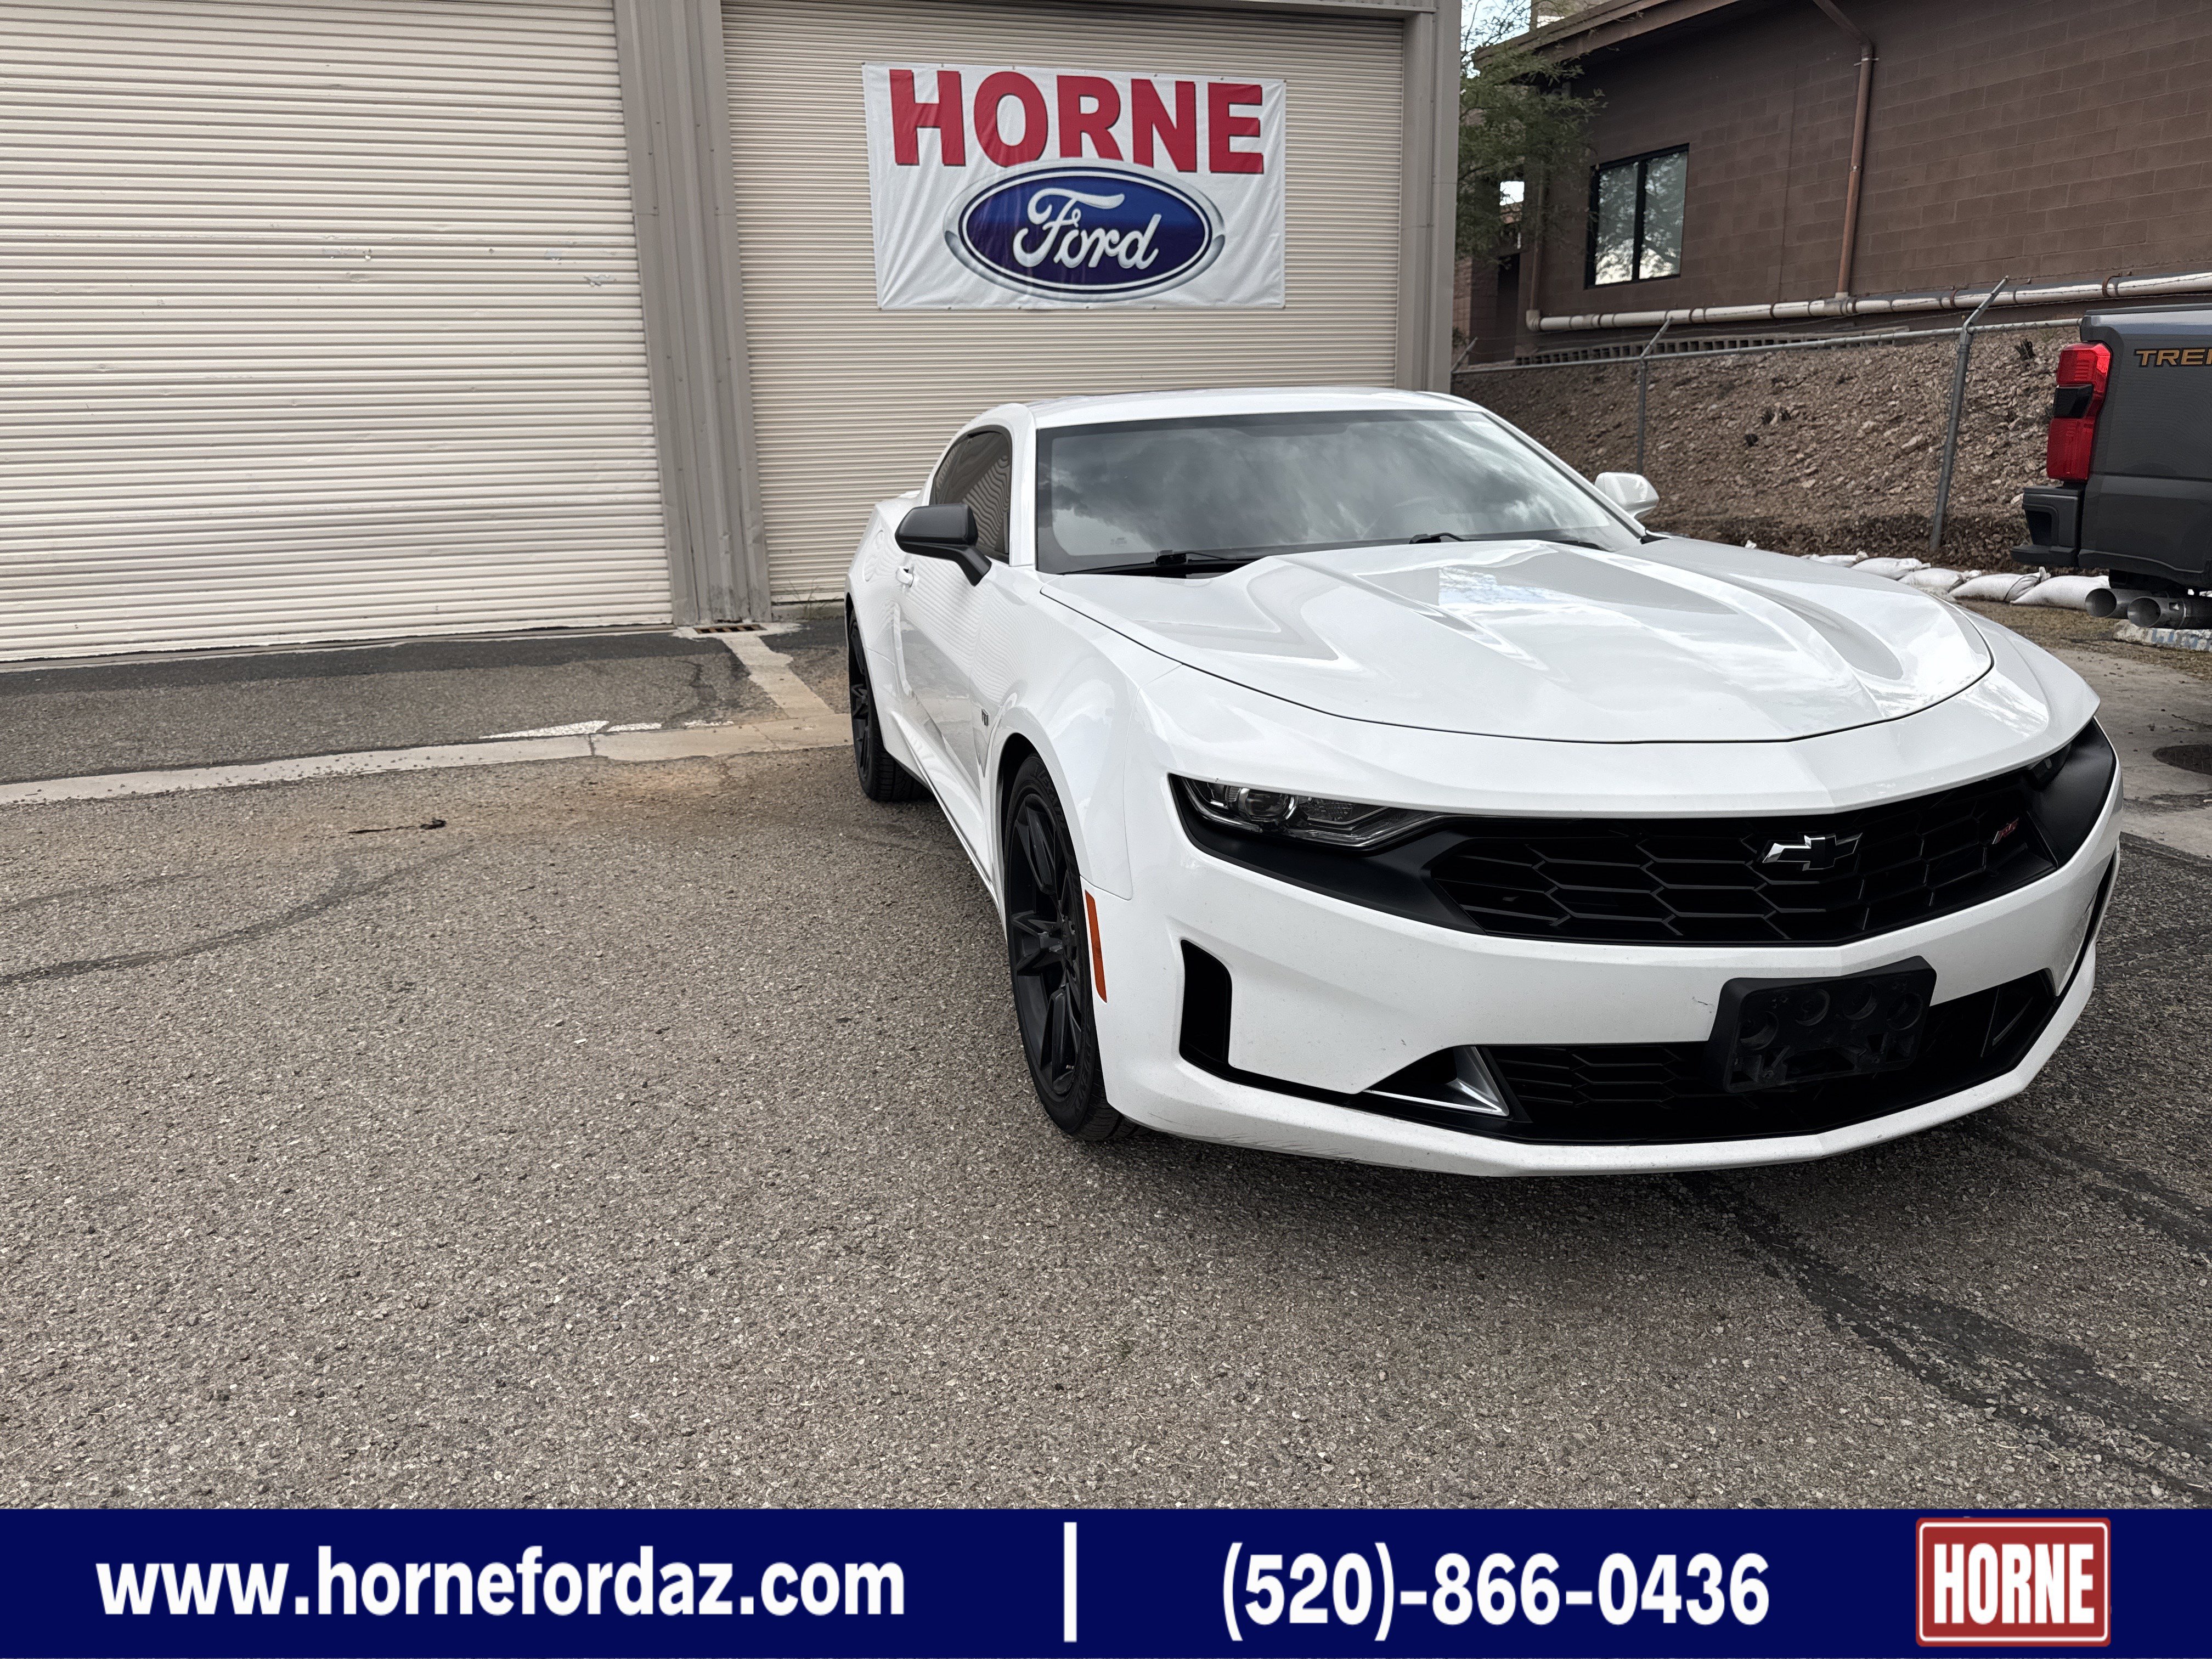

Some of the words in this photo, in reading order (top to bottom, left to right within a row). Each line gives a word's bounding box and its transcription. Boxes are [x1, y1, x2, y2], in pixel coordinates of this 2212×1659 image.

[889, 69, 1264, 174] HORNE
[1013, 187, 1162, 270] Ford
[2135, 348, 2212, 366] TRE
